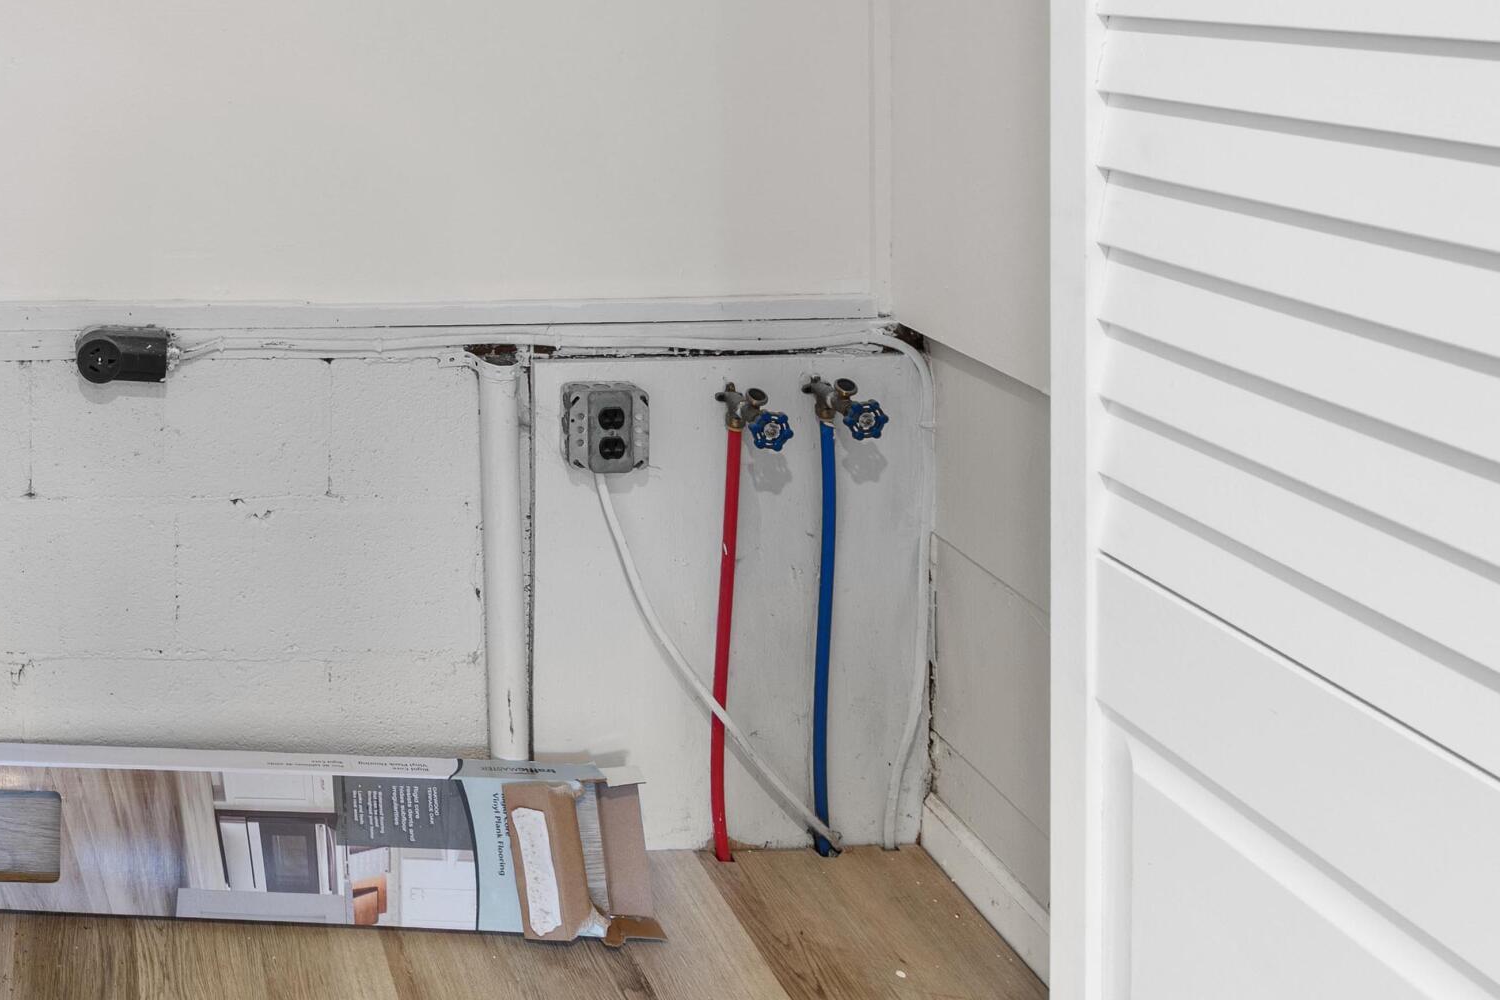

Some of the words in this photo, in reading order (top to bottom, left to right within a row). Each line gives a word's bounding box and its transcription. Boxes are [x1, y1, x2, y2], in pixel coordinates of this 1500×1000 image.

[492, 793, 500, 814] Vinyl
[495, 815, 503, 838] Plank
[498, 840, 506, 876] Flooring
